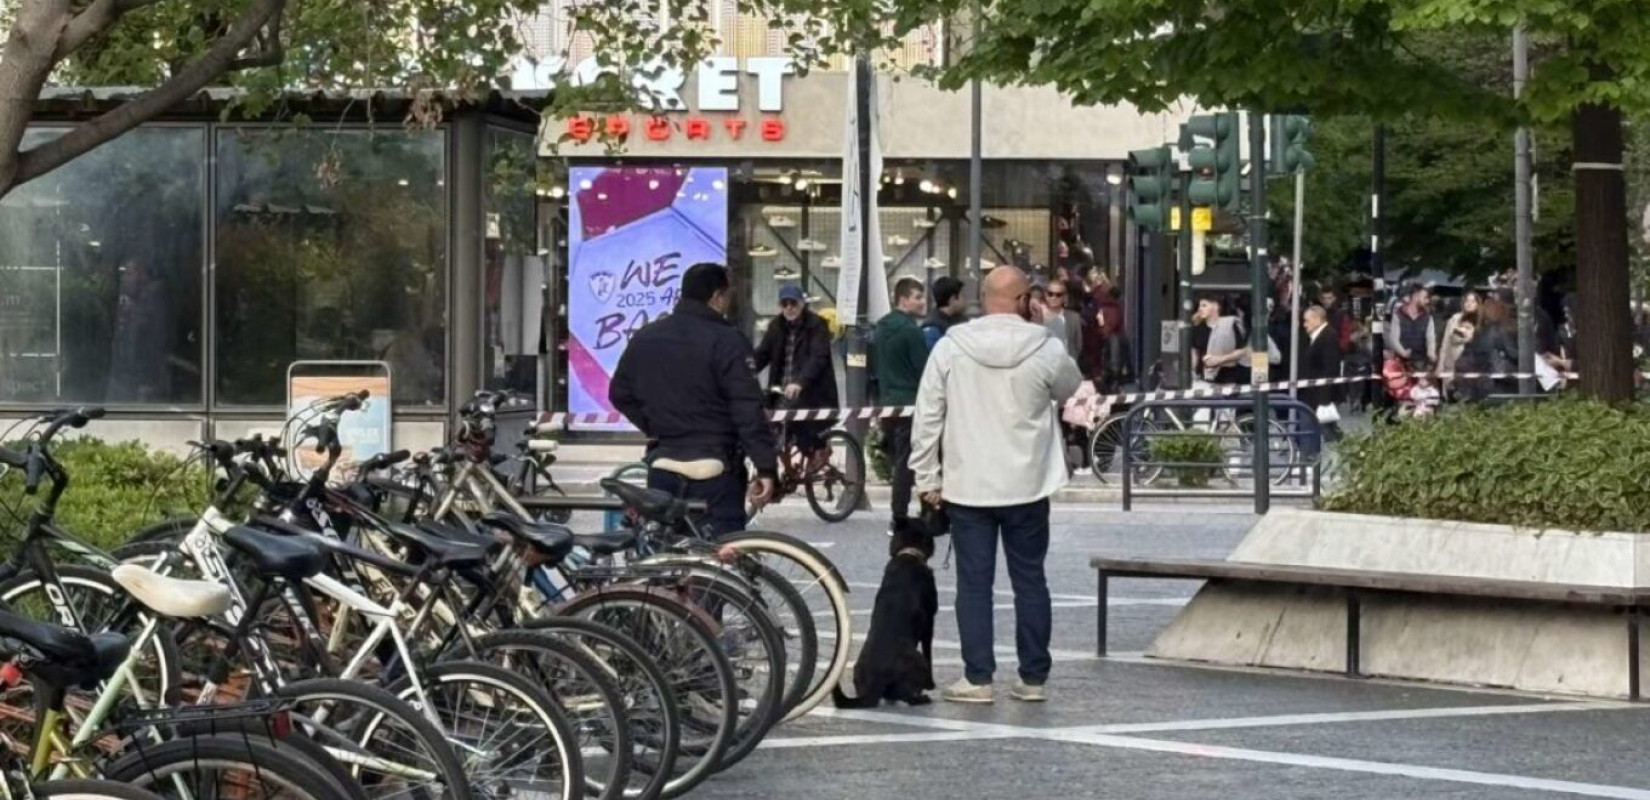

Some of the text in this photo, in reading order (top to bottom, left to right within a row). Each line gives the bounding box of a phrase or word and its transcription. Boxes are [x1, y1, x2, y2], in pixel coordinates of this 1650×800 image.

[567, 115, 786, 141] SPORTS
[620, 252, 681, 290] WE
[616, 291, 655, 308] 2025
[592, 309, 669, 349] BA
